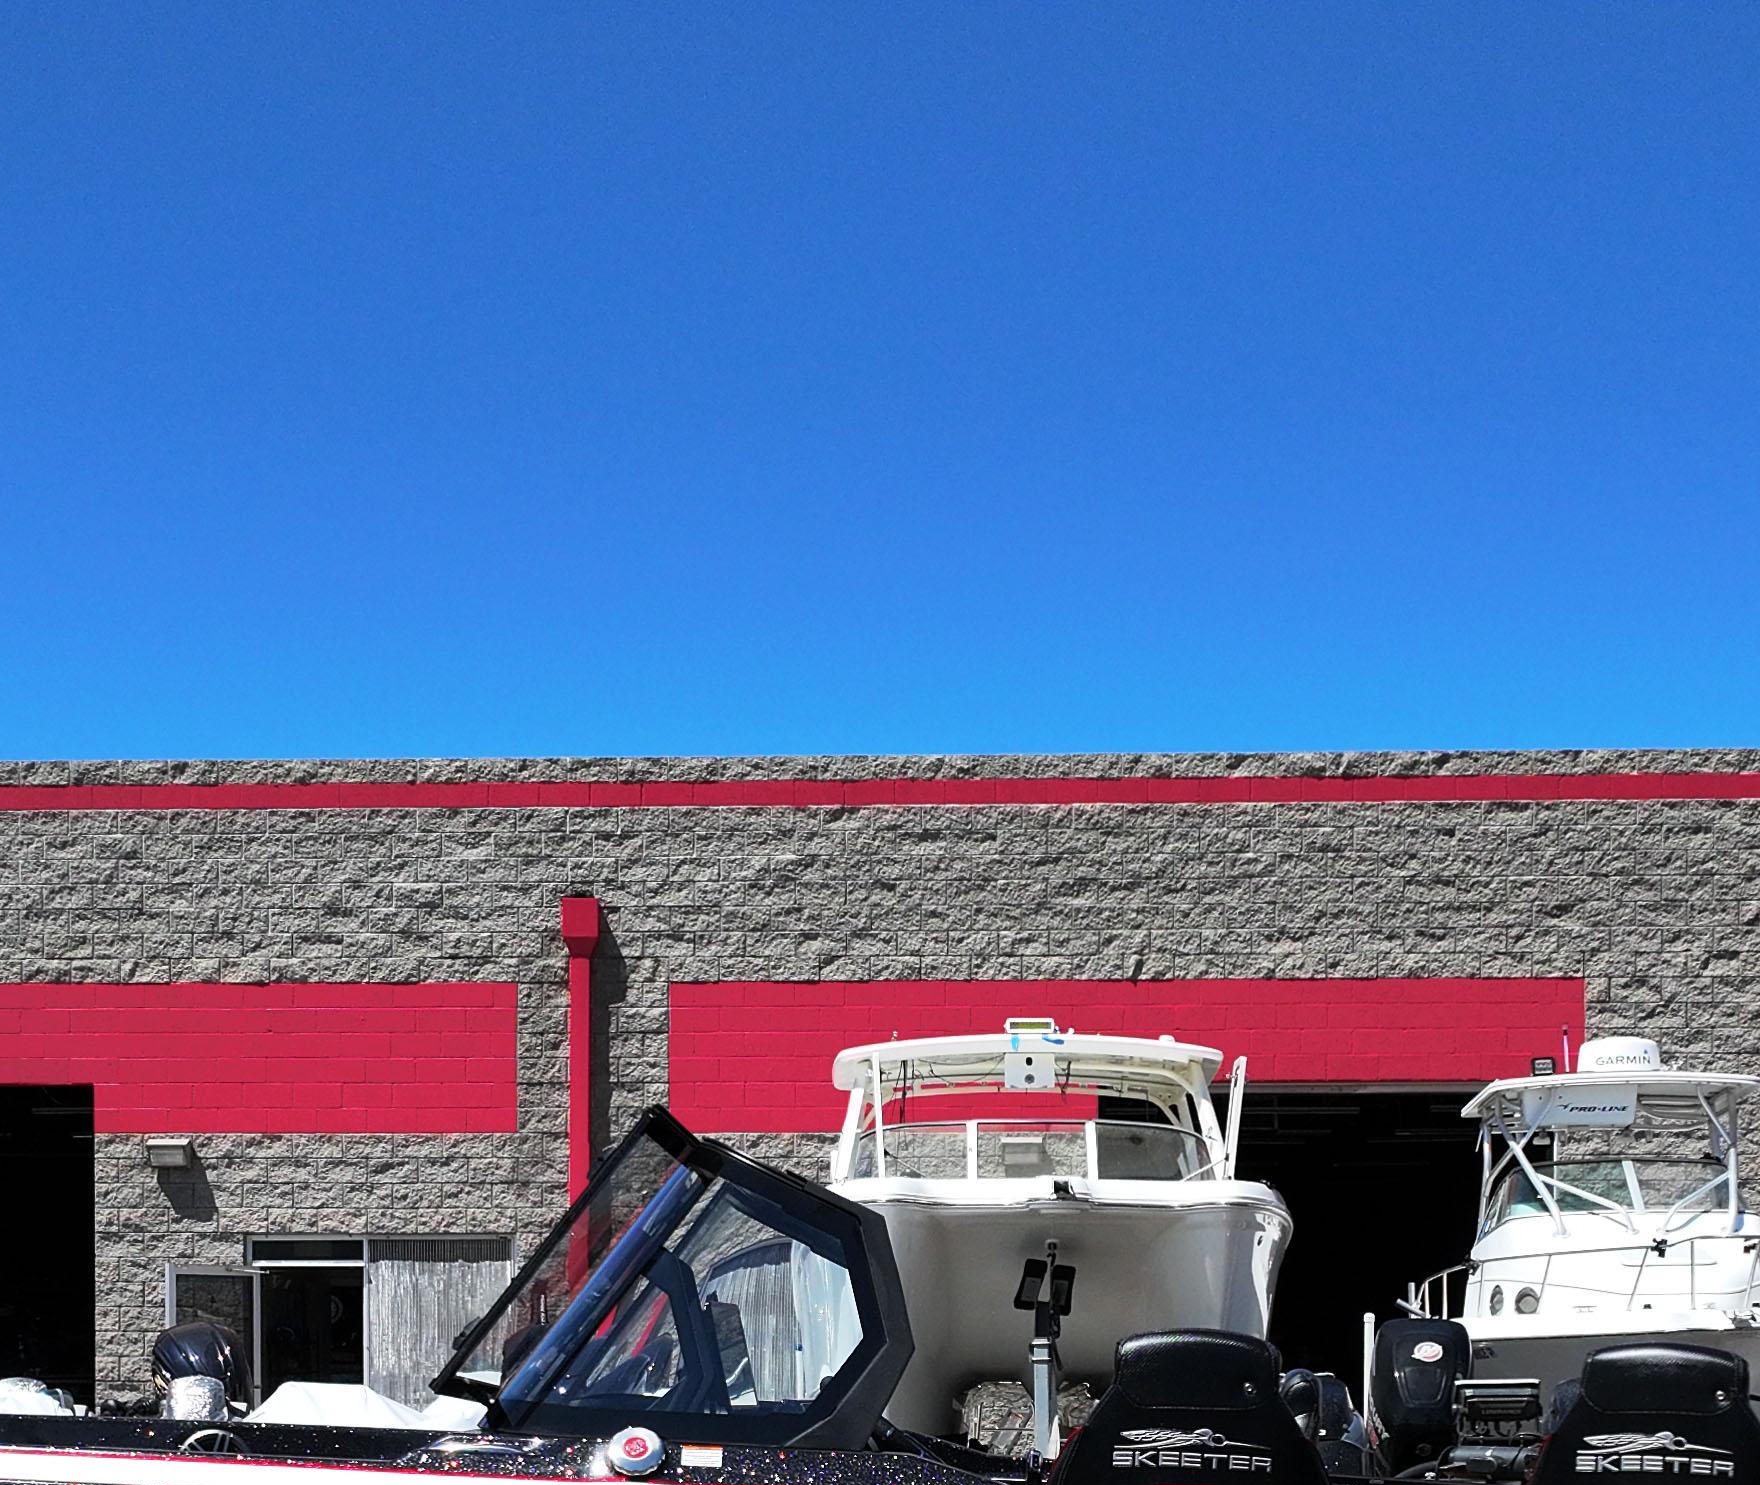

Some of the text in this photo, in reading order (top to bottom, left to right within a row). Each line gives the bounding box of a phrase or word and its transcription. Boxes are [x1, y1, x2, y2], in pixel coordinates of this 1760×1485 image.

[1595, 1055, 1651, 1066] GARMIN
[1112, 1450, 1273, 1473] SKEETER
[1575, 1454, 1735, 1478] SKEETER
